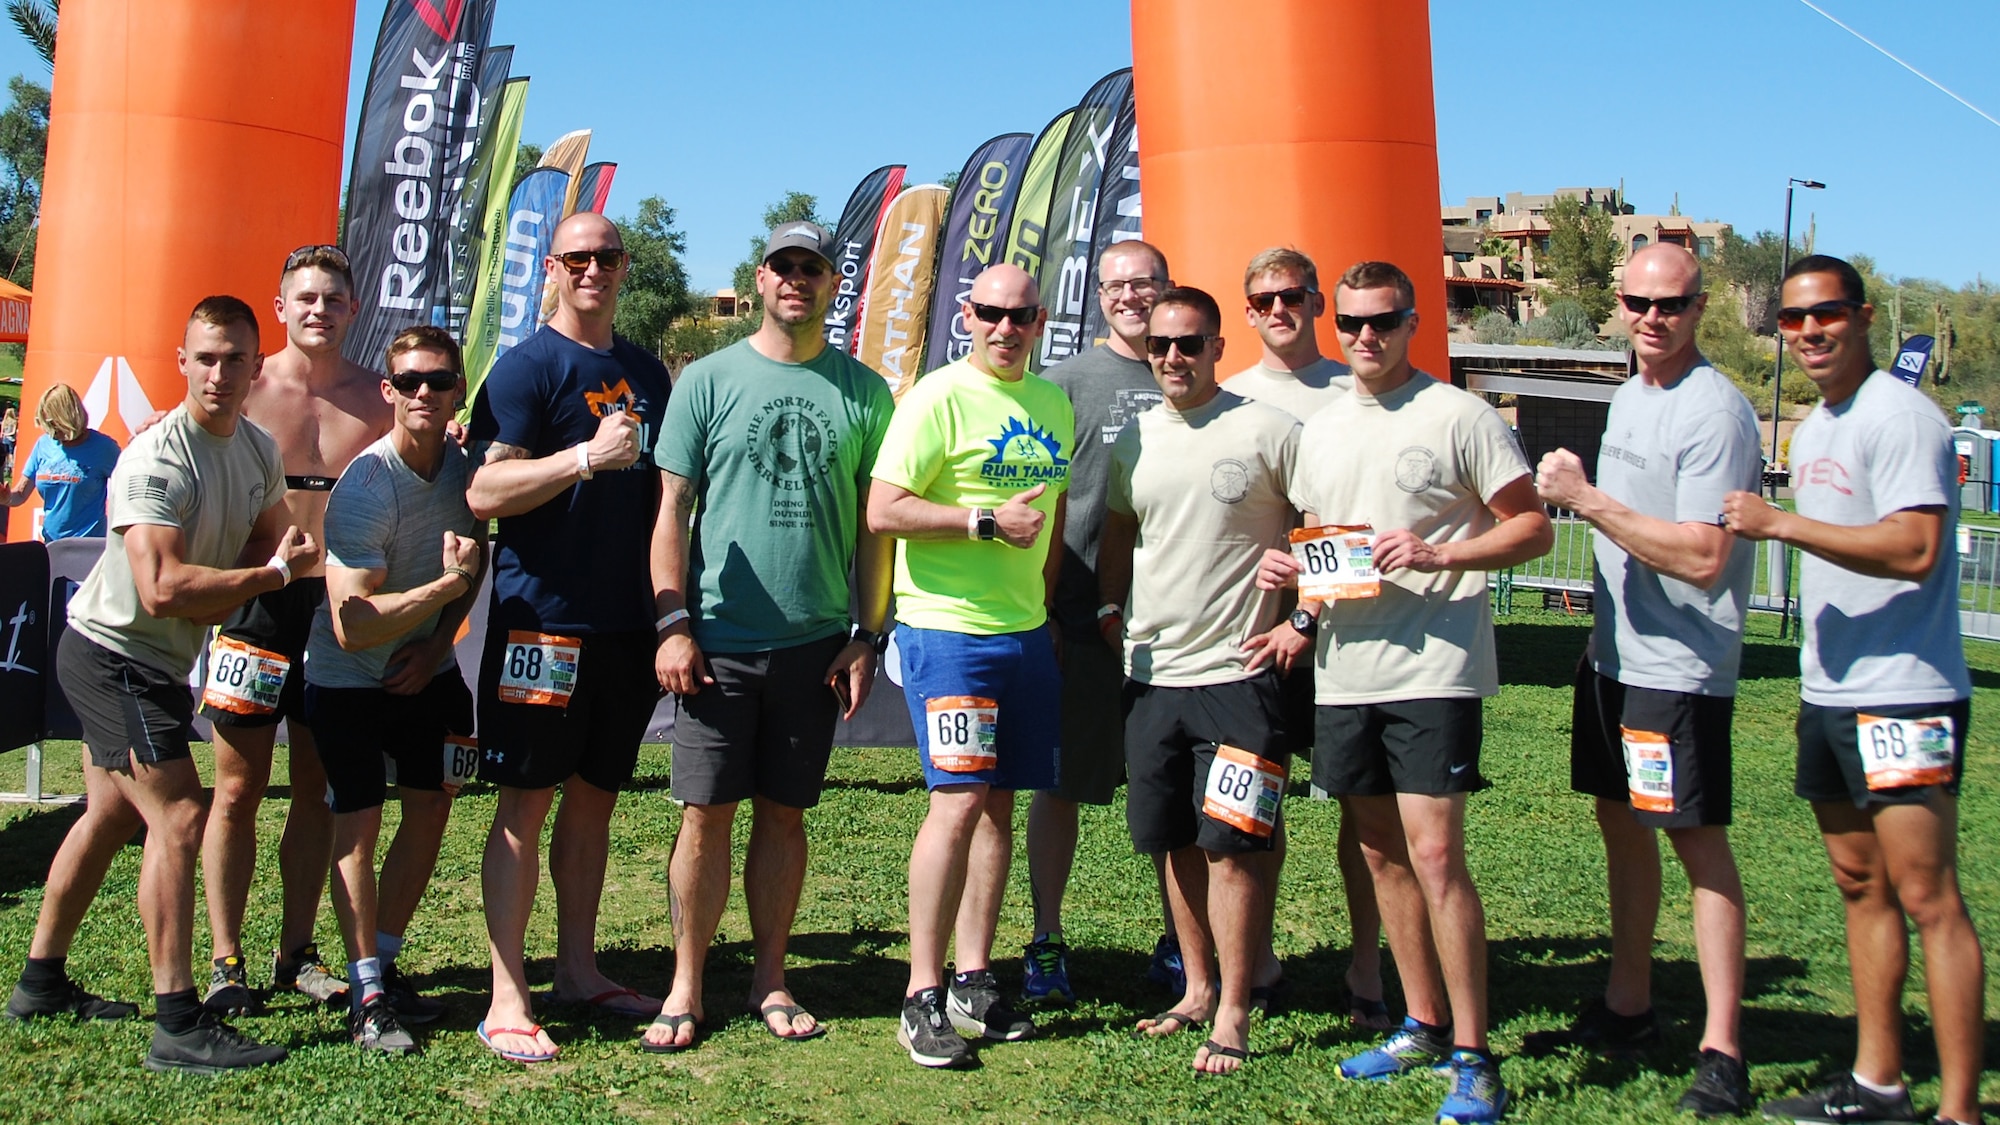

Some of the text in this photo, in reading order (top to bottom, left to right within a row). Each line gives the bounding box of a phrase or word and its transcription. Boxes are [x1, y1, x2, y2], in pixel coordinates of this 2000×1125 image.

[461, 43, 476, 80] BRAND
[379, 47, 450, 310] Reebok
[962, 160, 1006, 265] ZERO
[486, 272, 499, 324] intelligent
[825, 241, 863, 350] nksport
[747, 396, 838, 451] THE NORTH FACE
[981, 463, 1017, 478] RUN
[769, 520, 797, 528] SINCE
[1305, 540, 1338, 575] 68
[216, 653, 248, 687] 68
[510, 645, 543, 681] 68
[939, 712, 968, 745] 68
[1871, 721, 1906, 760] 68
[453, 745, 478, 779] 68
[1218, 764, 1253, 801] 68
